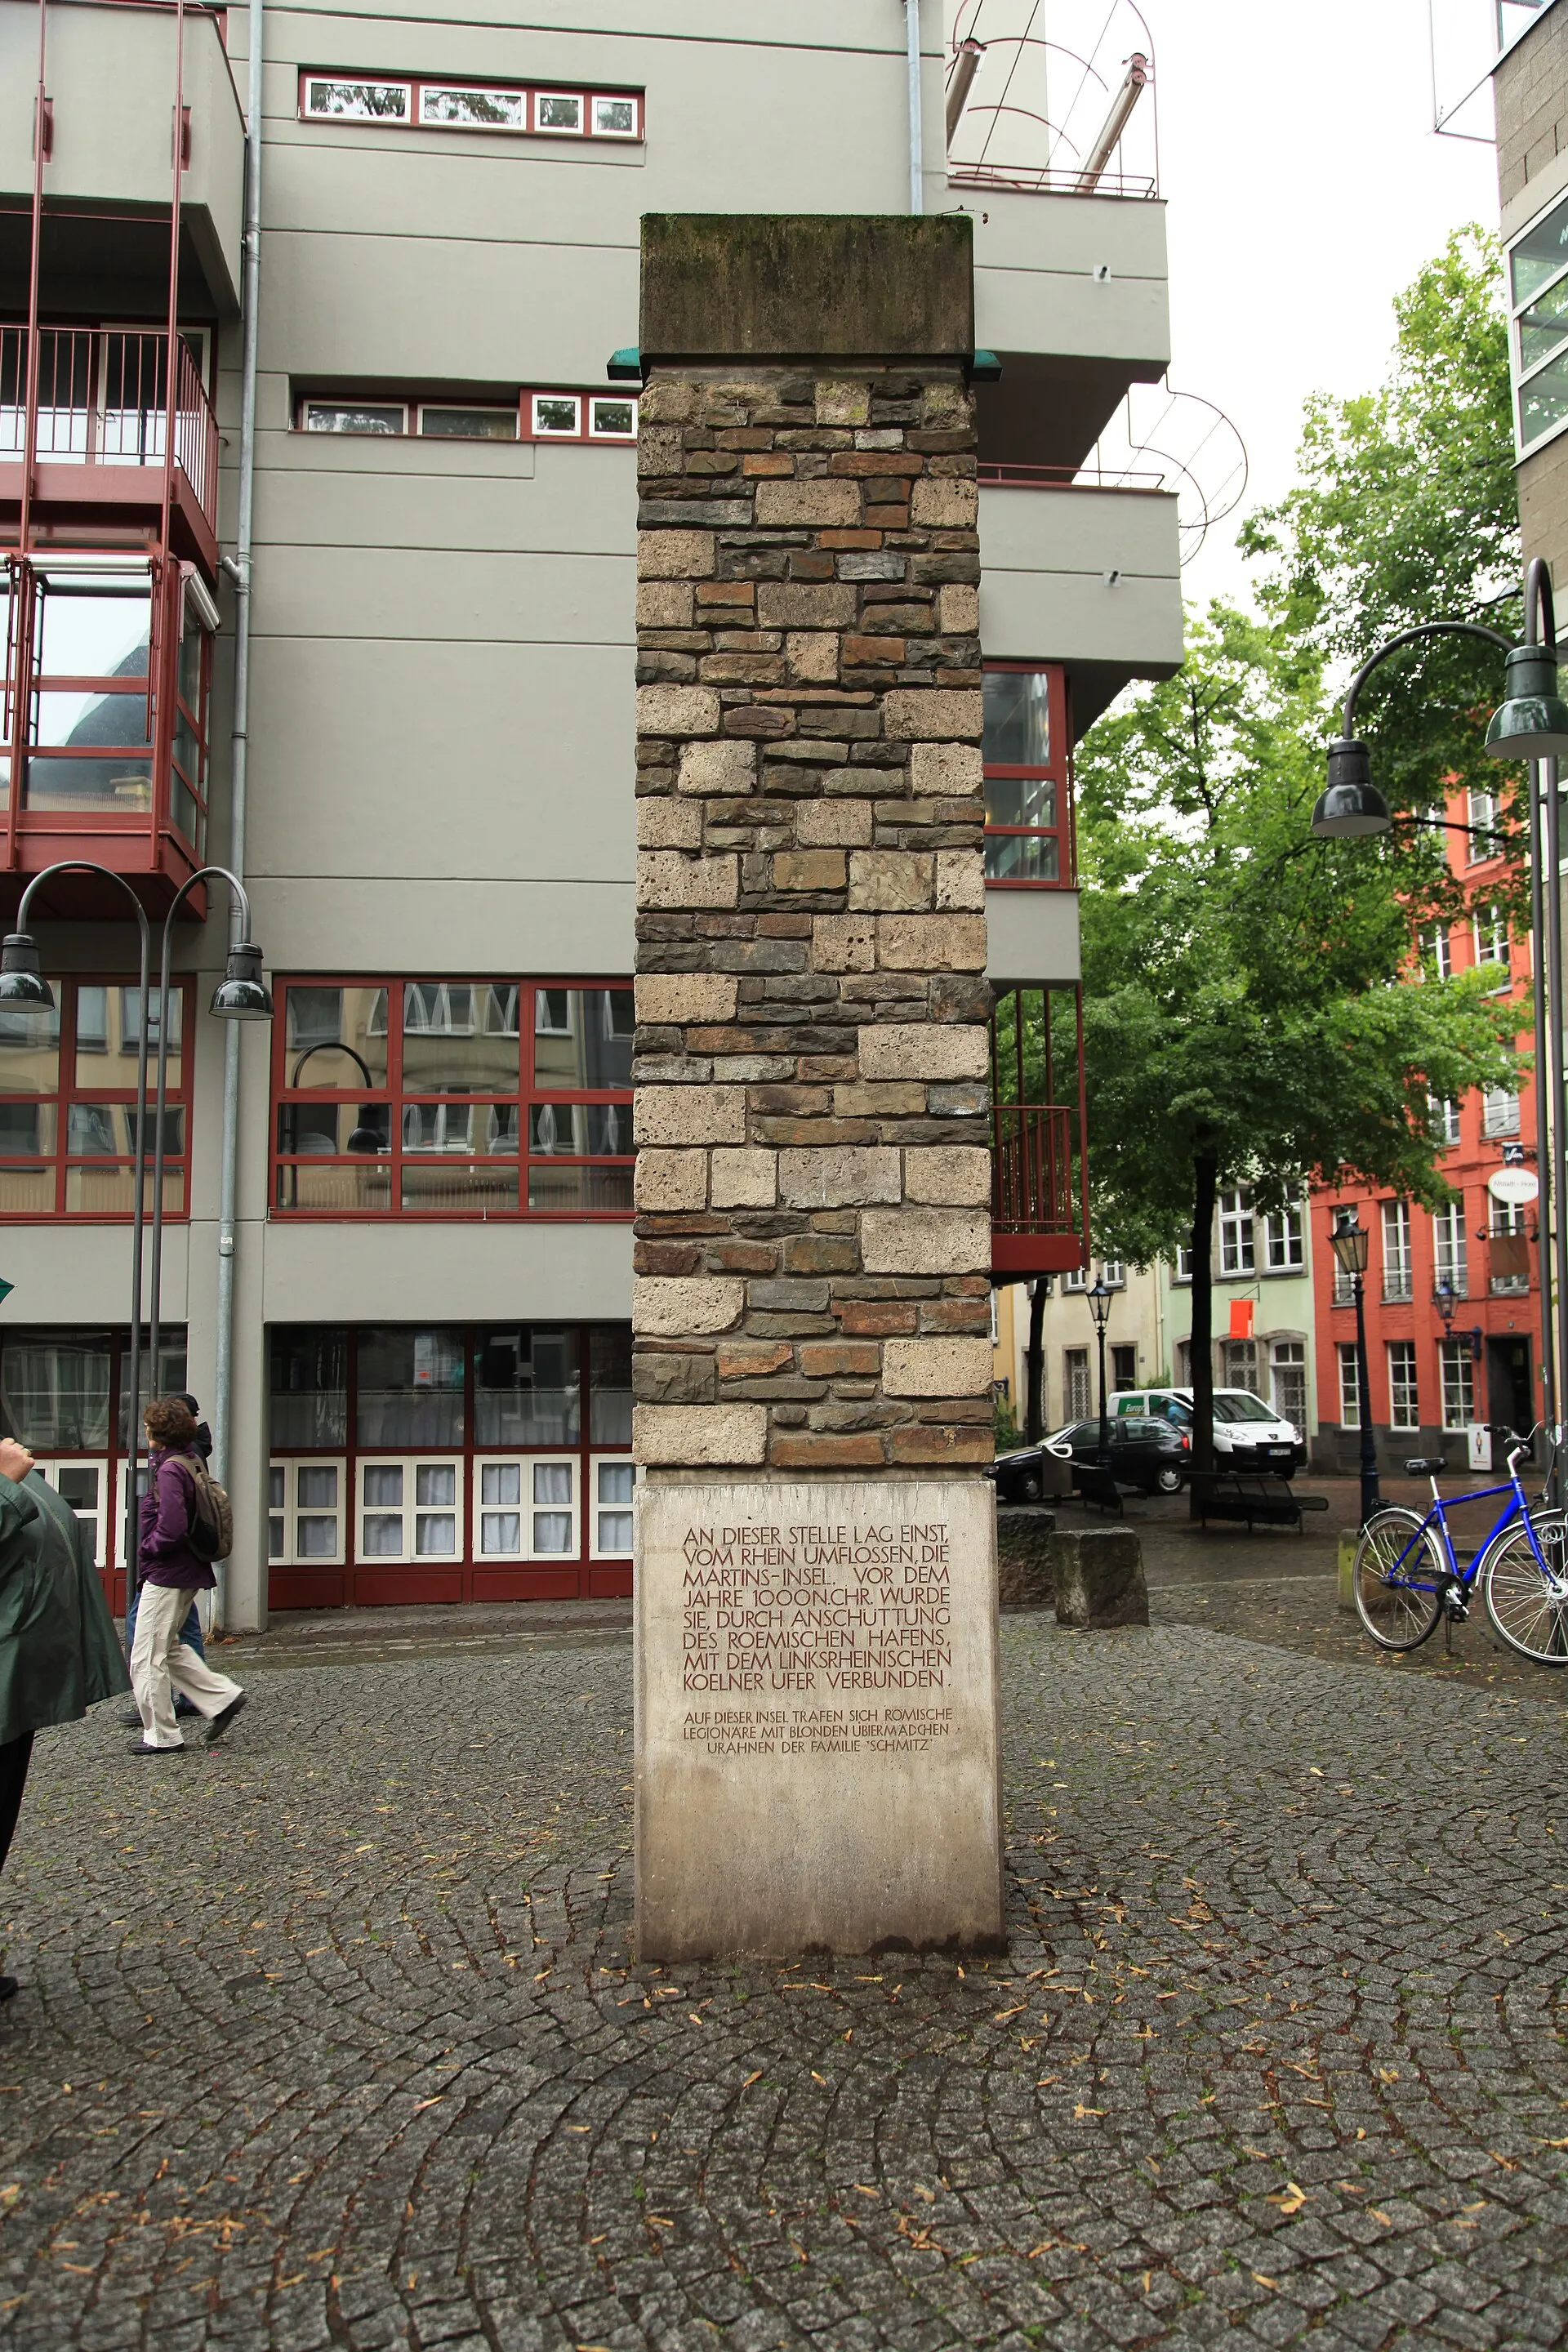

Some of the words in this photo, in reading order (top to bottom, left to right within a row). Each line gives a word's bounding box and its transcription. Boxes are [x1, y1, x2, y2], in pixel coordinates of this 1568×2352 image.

[683, 1527, 714, 1546] AN
[723, 1526, 782, 1546] DIESER
[789, 1526, 847, 1544] STELLE
[853, 1525, 893, 1544] LAG
[901, 1523, 949, 1544] EINST,
[683, 1548, 734, 1566] VOM
[741, 1547, 796, 1566] RHEIN
[804, 1545, 919, 1565] UMFLOSSEN,
[921, 1545, 950, 1563] DIE
[683, 1567, 836, 1588] MARTINS-INSEL.
[853, 1566, 894, 1585] VOR
[904, 1565, 951, 1584] DEM
[683, 1589, 744, 1608] JAHRE
[880, 1586, 951, 1606] WURDE
[683, 1610, 710, 1631] SIE,
[716, 1610, 783, 1628] DURCH
[791, 1606, 951, 1628] ANSCHÜTTUNG
[683, 1632, 718, 1650] DES
[728, 1629, 855, 1649] ROEMISCHEN
[868, 1628, 951, 1647] HAFENS,
[684, 1651, 719, 1671] MIT
[727, 1651, 773, 1671] DEM
[779, 1648, 952, 1670] LINKSRHEINISCHEN
[684, 1673, 765, 1691] KOELNER
[772, 1672, 817, 1690] UFER
[684, 1711, 711, 1725] AUF
[715, 1711, 754, 1724] DIESER
[755, 1710, 789, 1724] INSEL
[792, 1709, 844, 1723] TRAFEN
[849, 1709, 878, 1722] SICH
[884, 1707, 953, 1722] RÖMISCHE
[684, 1726, 757, 1740] LEGIONÄRE
[760, 1726, 786, 1740] MIT
[789, 1724, 849, 1739] BLONDEN
[707, 1740, 775, 1755] URAHNEN
[781, 1740, 805, 1754] DER
[810, 1740, 861, 1753] FAMILIE
